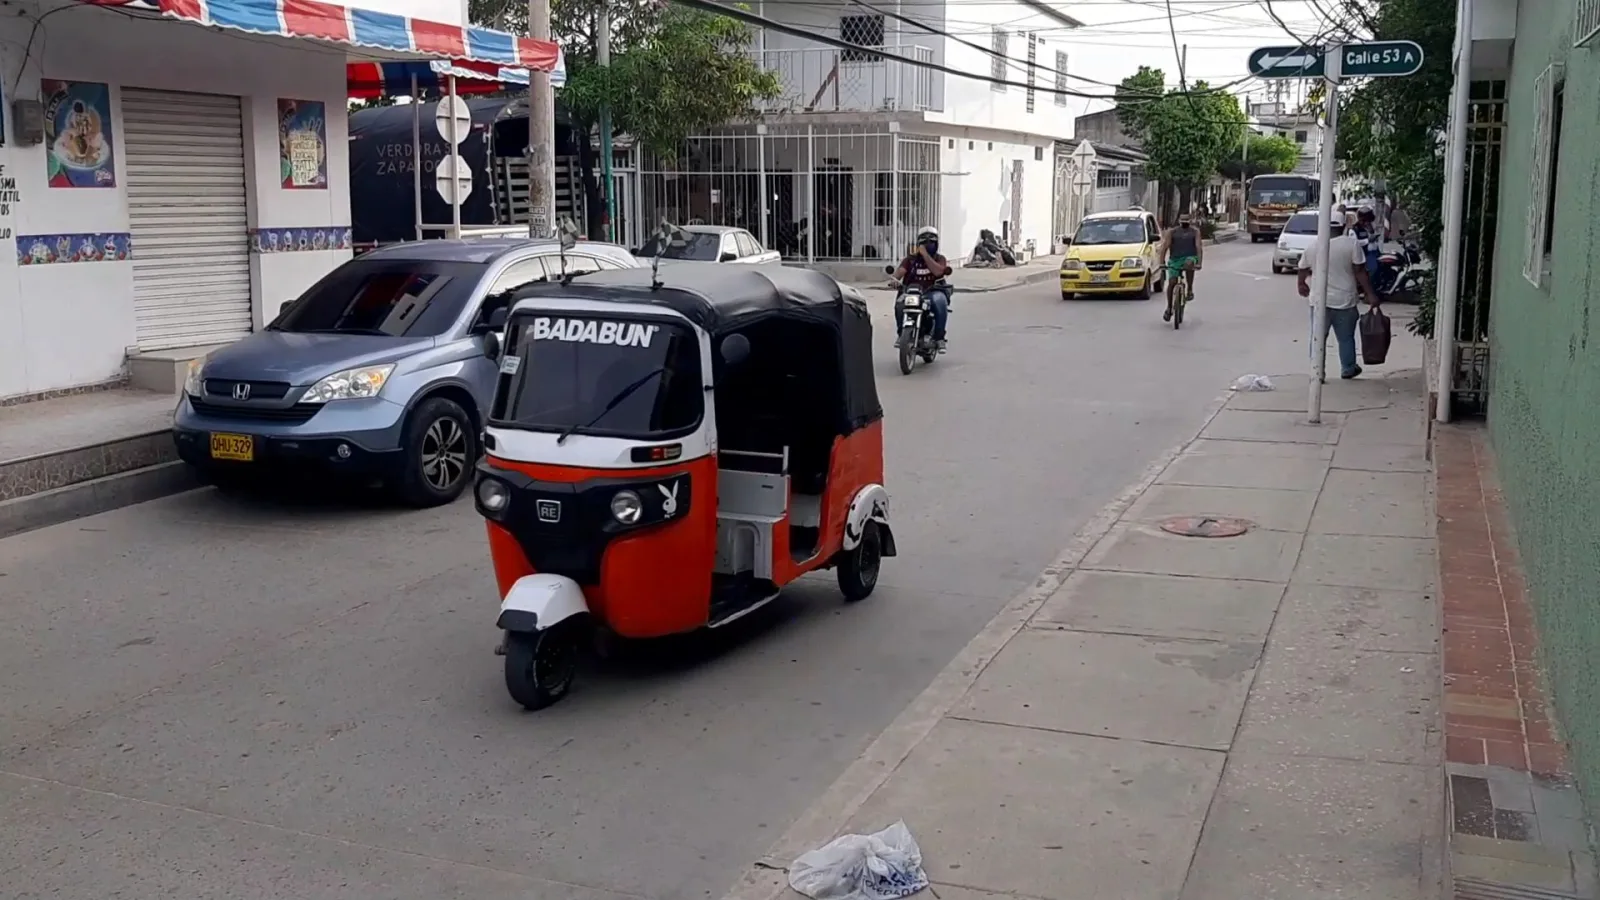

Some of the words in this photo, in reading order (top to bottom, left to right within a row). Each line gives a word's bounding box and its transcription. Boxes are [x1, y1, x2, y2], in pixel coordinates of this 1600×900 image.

[1382, 48, 1400, 64] 53
[1403, 51, 1414, 64] A
[540, 506, 557, 519] RE
